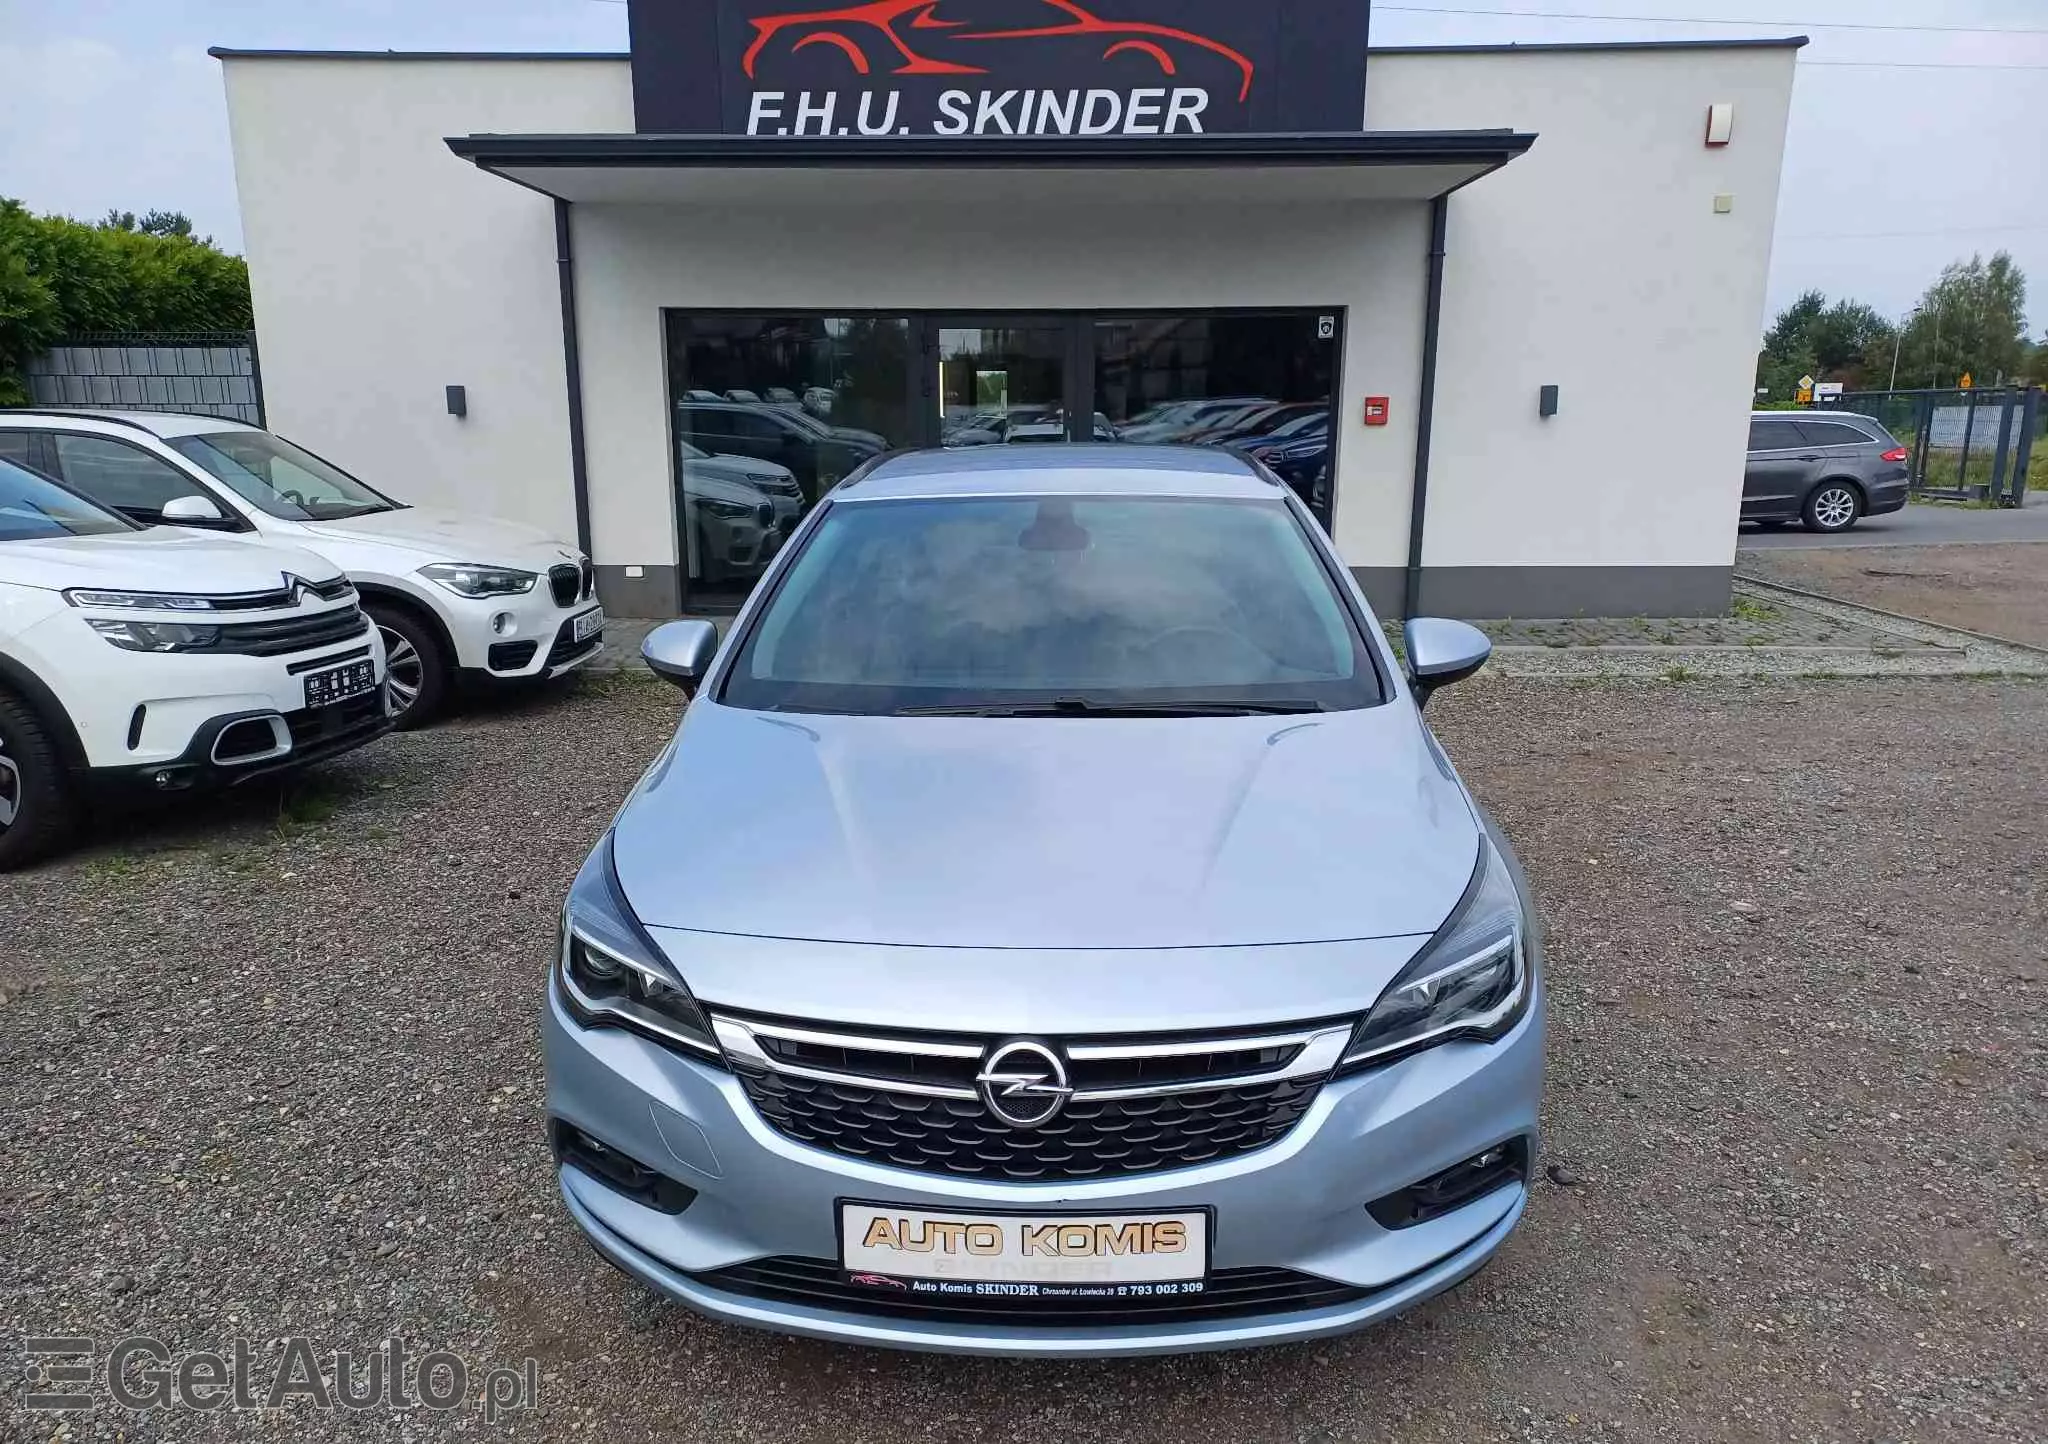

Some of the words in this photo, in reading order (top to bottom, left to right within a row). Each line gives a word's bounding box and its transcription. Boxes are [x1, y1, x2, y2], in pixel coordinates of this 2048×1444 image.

[746, 91, 910, 136] F.H.U.
[933, 87, 1209, 136] SKINDER
[863, 1216, 1004, 1256] AUTO
[1021, 1220, 1188, 1258] KOMIS
[912, 1280, 937, 1292] Auto
[940, 1282, 973, 1294] Komis
[975, 1283, 1039, 1296] SKINDER
[1130, 1285, 1152, 1296] 793
[1155, 1284, 1178, 1295] 002
[1181, 1282, 1204, 1293] 309
